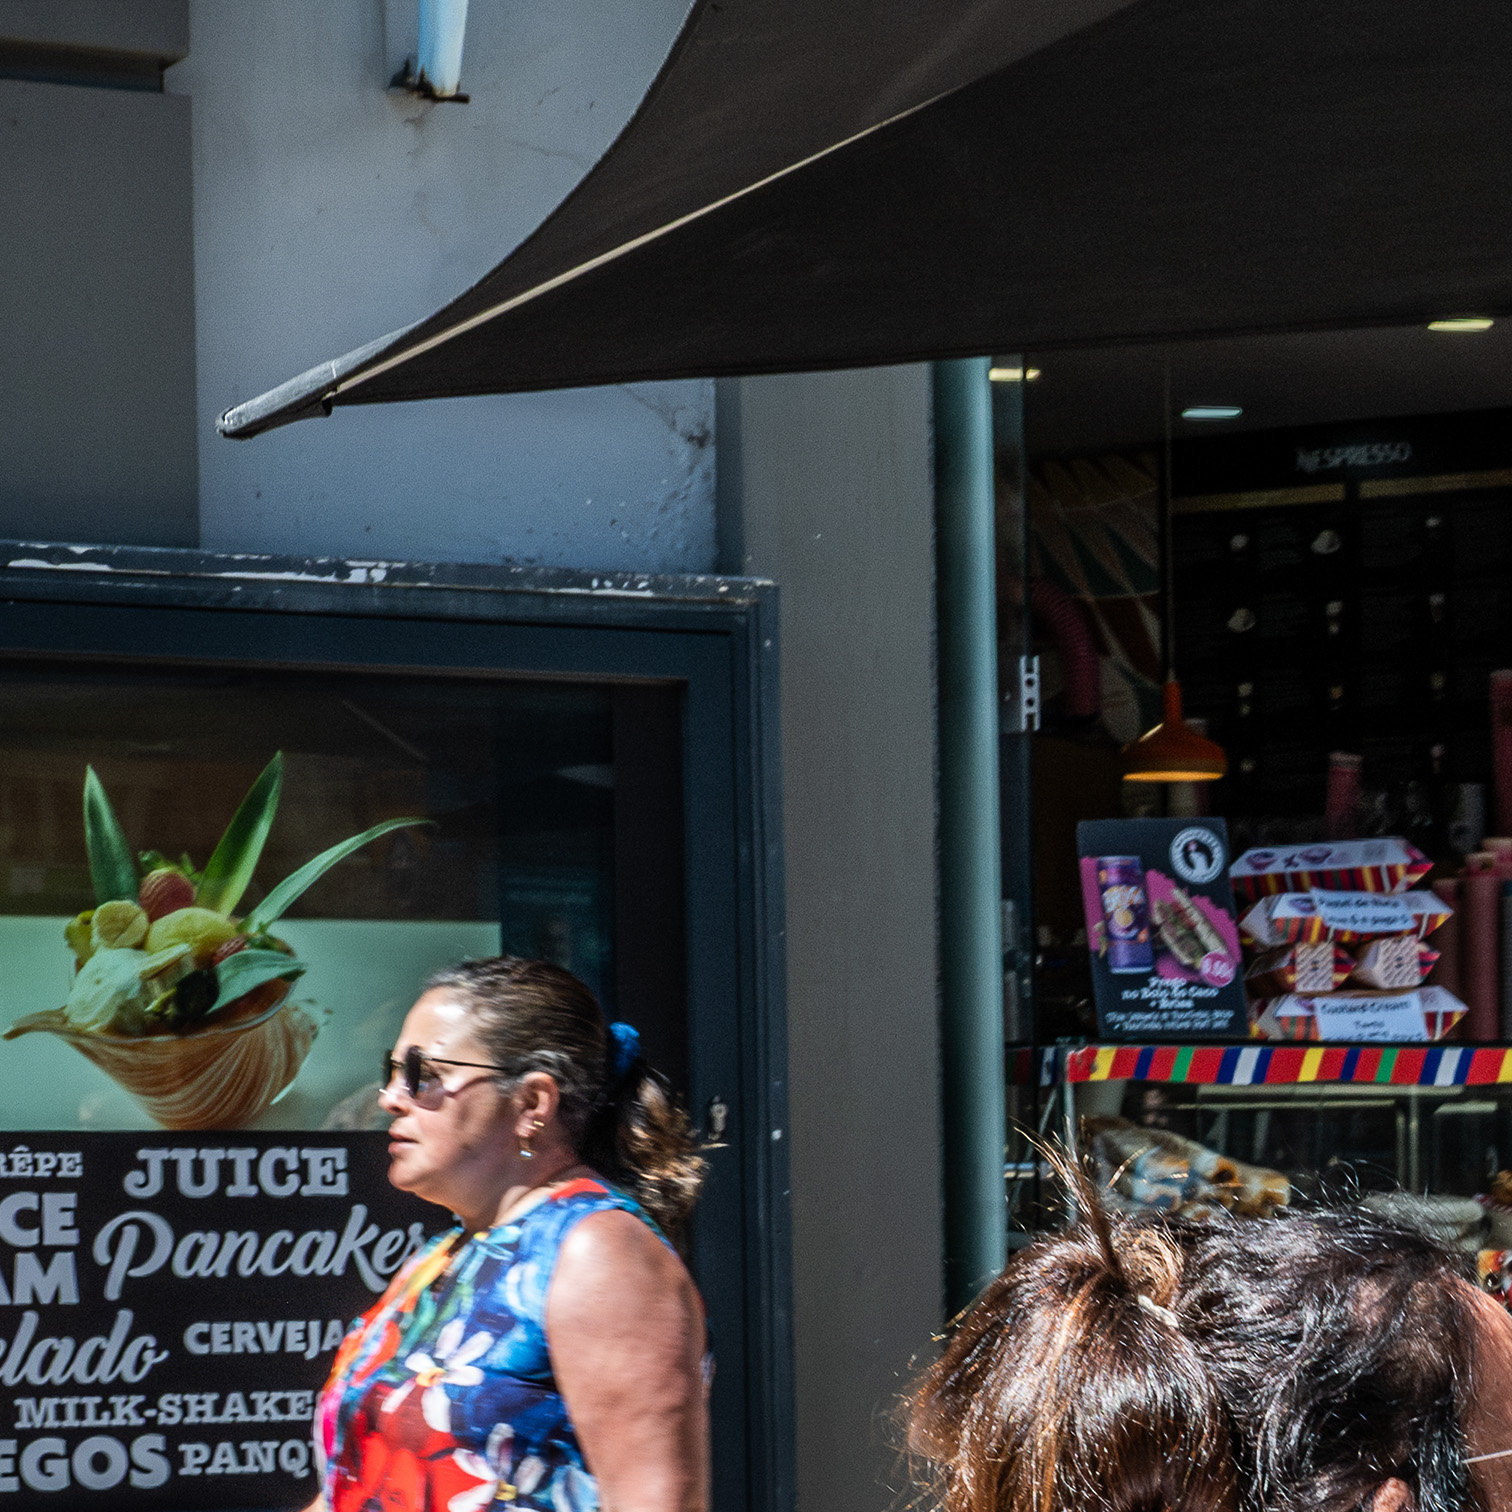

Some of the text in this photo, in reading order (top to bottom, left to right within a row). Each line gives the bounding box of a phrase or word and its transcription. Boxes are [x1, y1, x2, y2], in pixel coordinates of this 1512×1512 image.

[123, 1147, 349, 1198] JUICE
[0, 1308, 169, 1387] lado
[14, 1390, 322, 1429] MILK-SHAKE
[178, 1438, 314, 1479] PANQ
